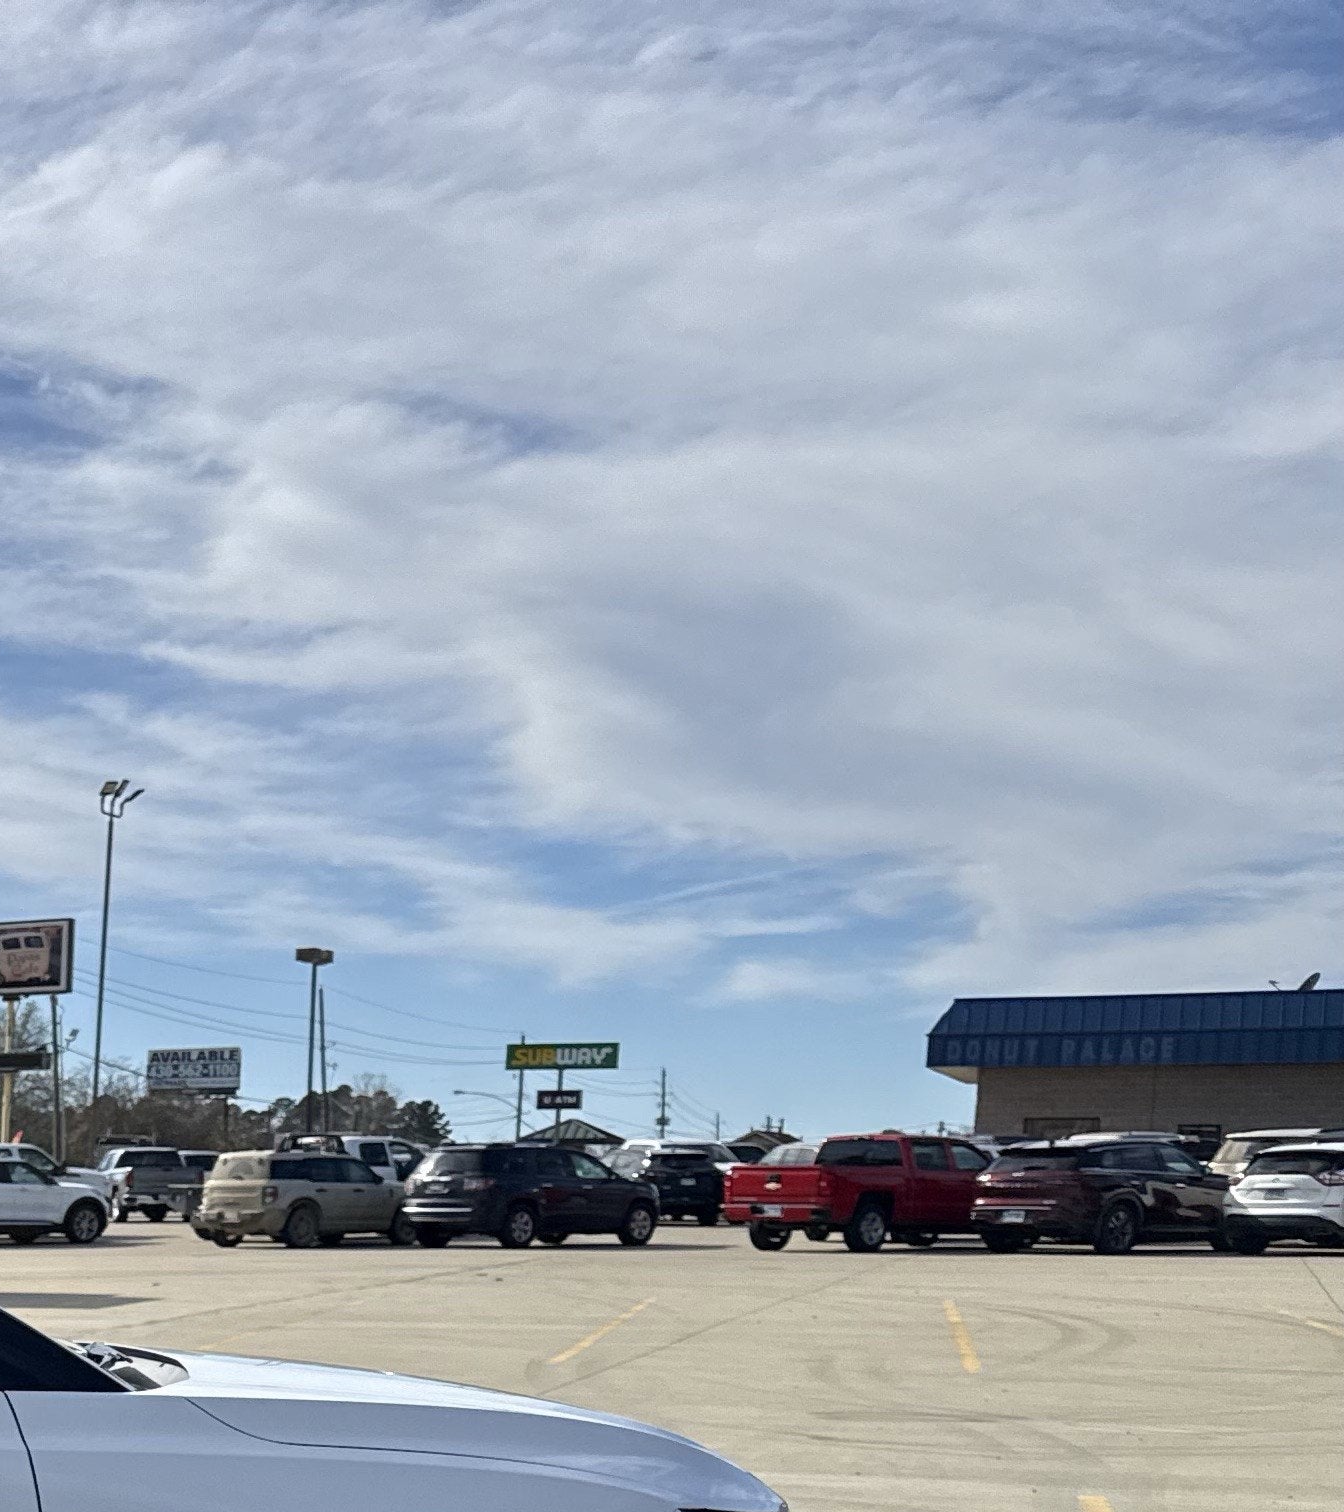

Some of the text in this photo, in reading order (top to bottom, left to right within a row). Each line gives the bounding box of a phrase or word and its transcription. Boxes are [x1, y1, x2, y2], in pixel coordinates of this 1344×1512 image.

[150, 1049, 239, 1063] AVAILABLE
[512, 1046, 613, 1066] SUBWAY
[946, 1036, 1175, 1062] DONUT PALACE
